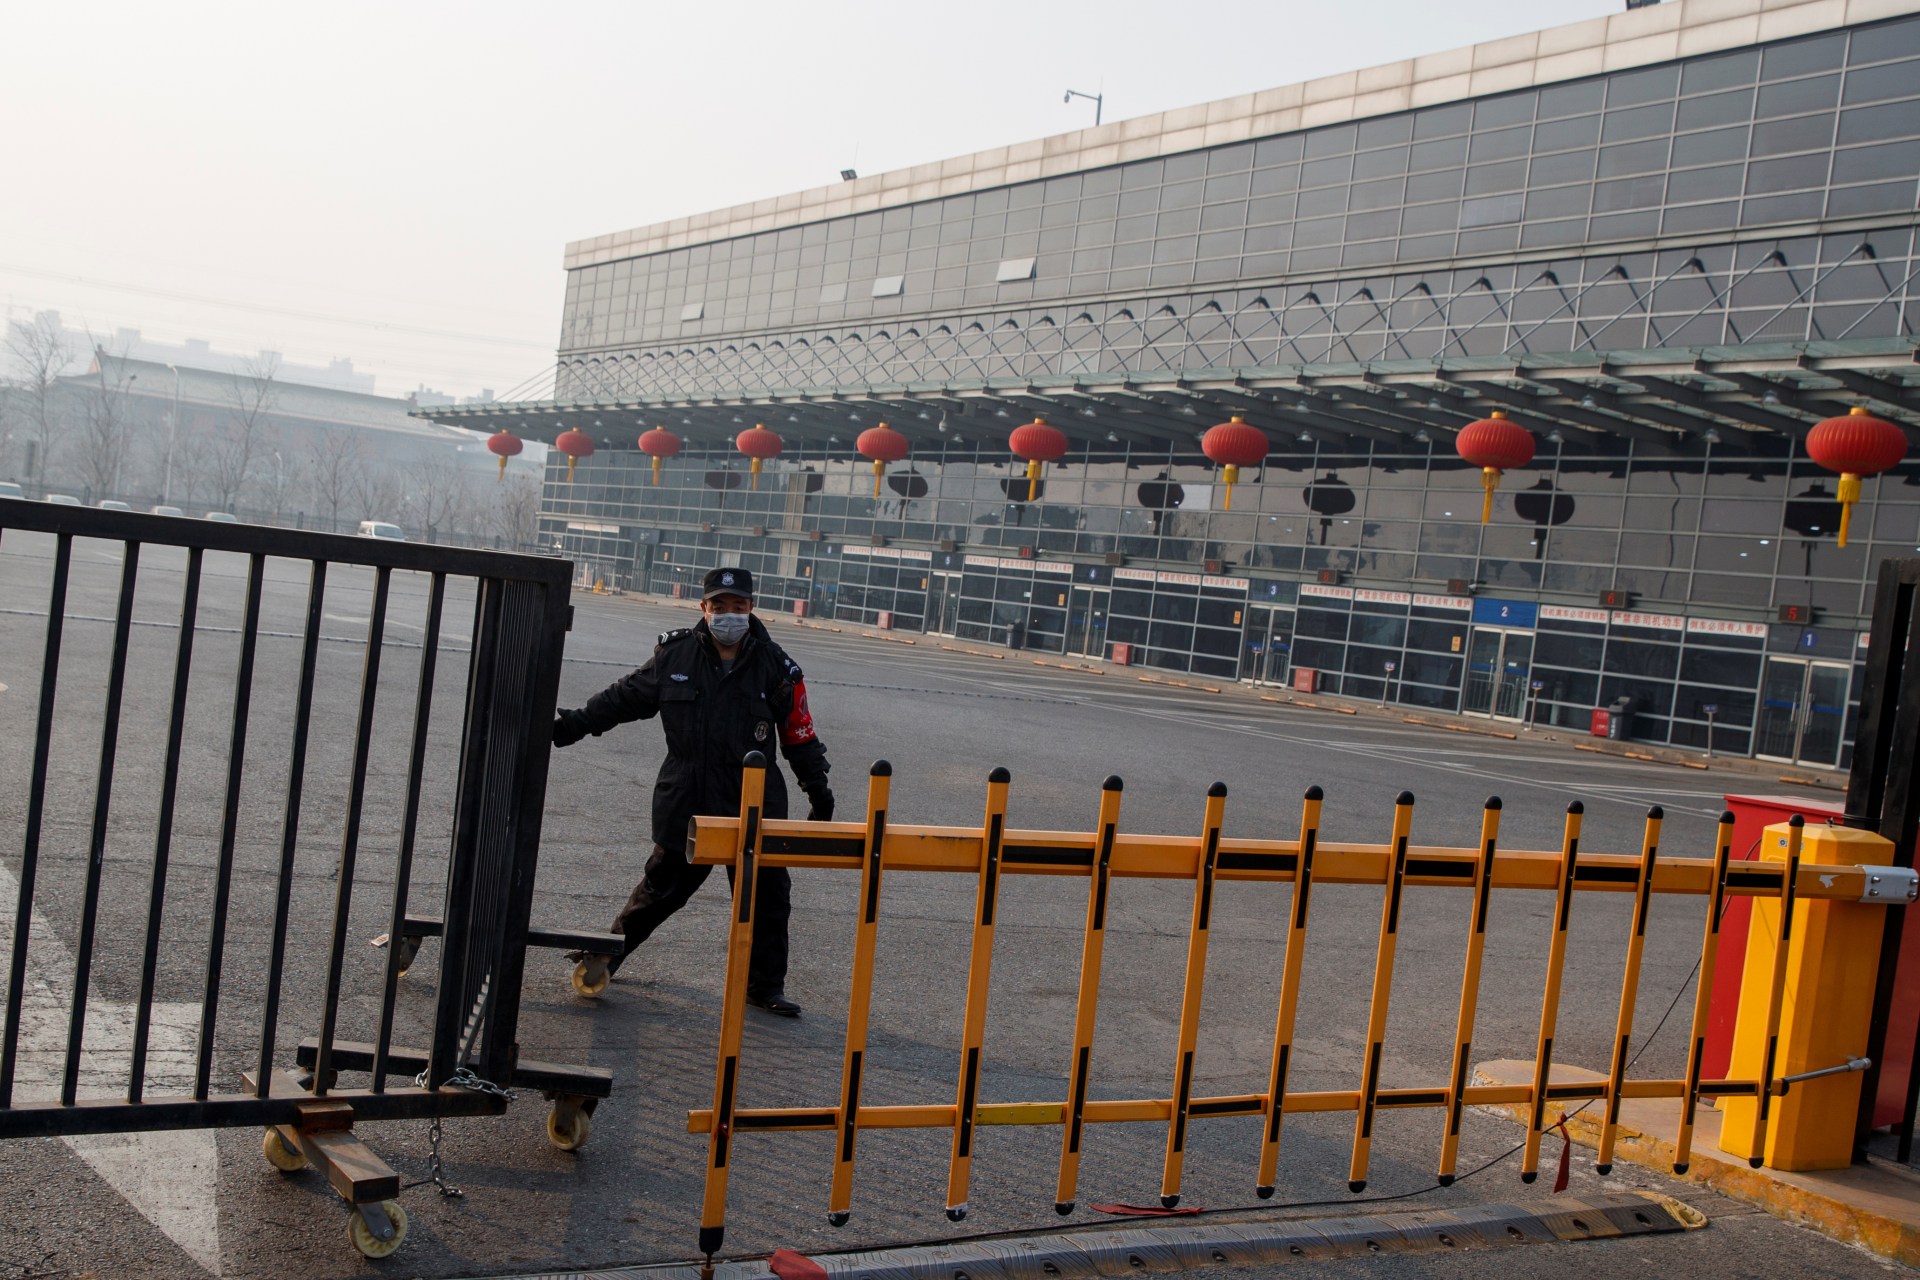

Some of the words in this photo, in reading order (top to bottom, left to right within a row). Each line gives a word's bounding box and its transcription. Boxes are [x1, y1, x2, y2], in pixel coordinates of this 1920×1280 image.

[1270, 585, 1277, 596] 3
[1501, 606, 1509, 617] 2
[1787, 607, 1797, 621] 5
[1806, 633, 1813, 646] 1
